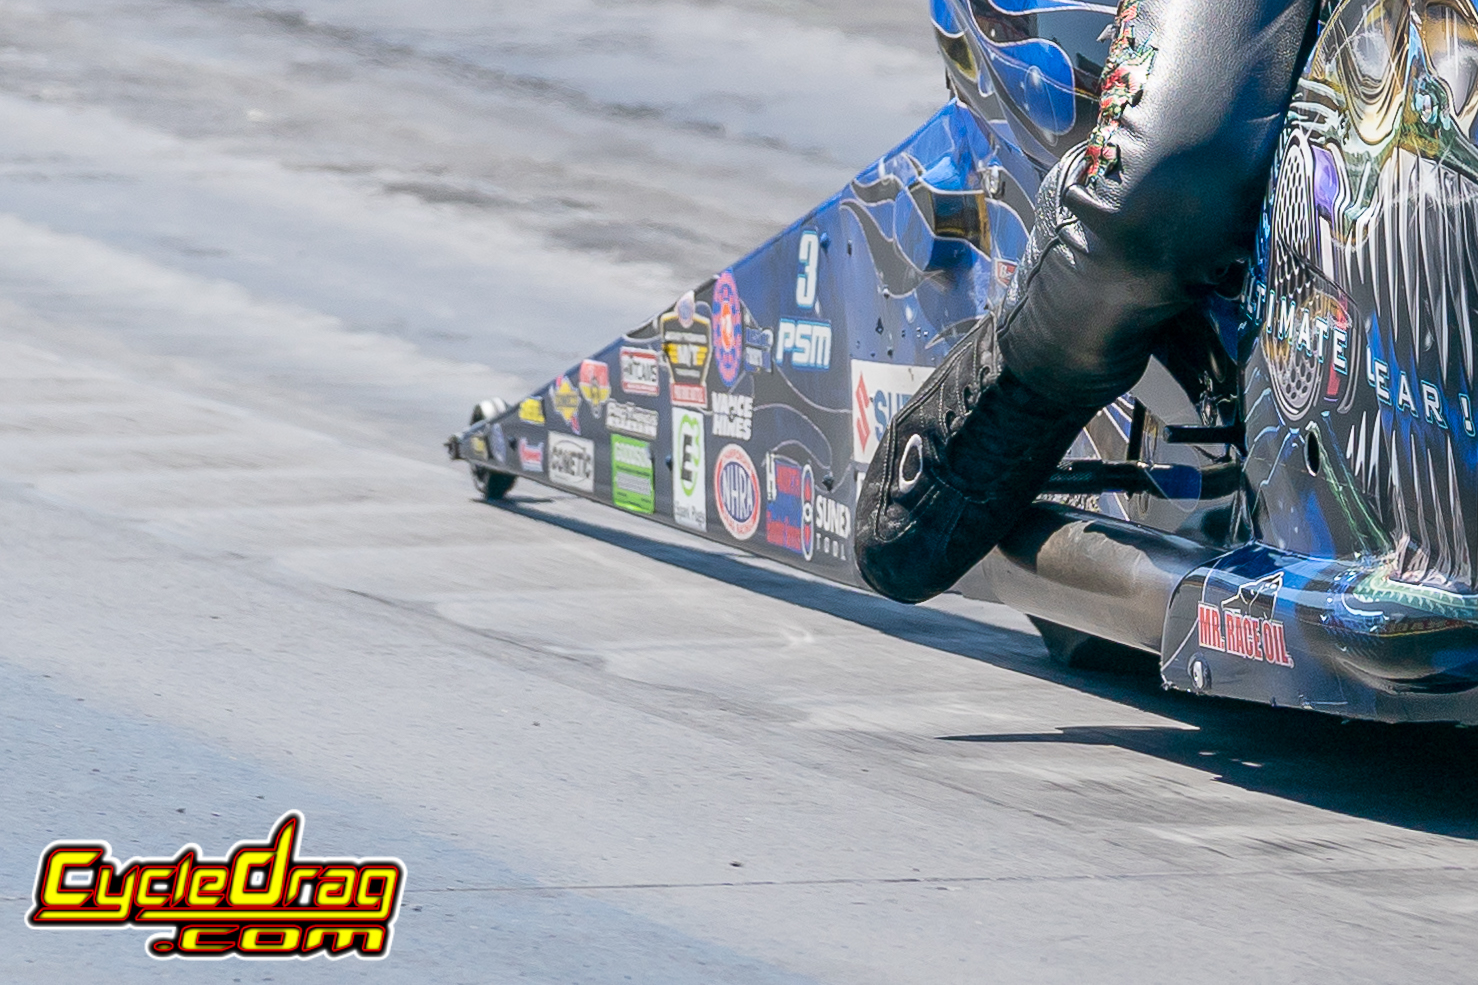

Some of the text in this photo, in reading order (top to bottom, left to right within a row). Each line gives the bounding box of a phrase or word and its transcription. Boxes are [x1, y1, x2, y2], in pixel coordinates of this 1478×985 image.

[796, 229, 820, 309] 3
[776, 318, 832, 370] PSM
[712, 391, 754, 418] VANCE
[713, 414, 752, 441] HINES
[721, 463, 756, 522] NHRA
[1198, 602, 1225, 651] MR.
[1225, 610, 1263, 661] RACE
